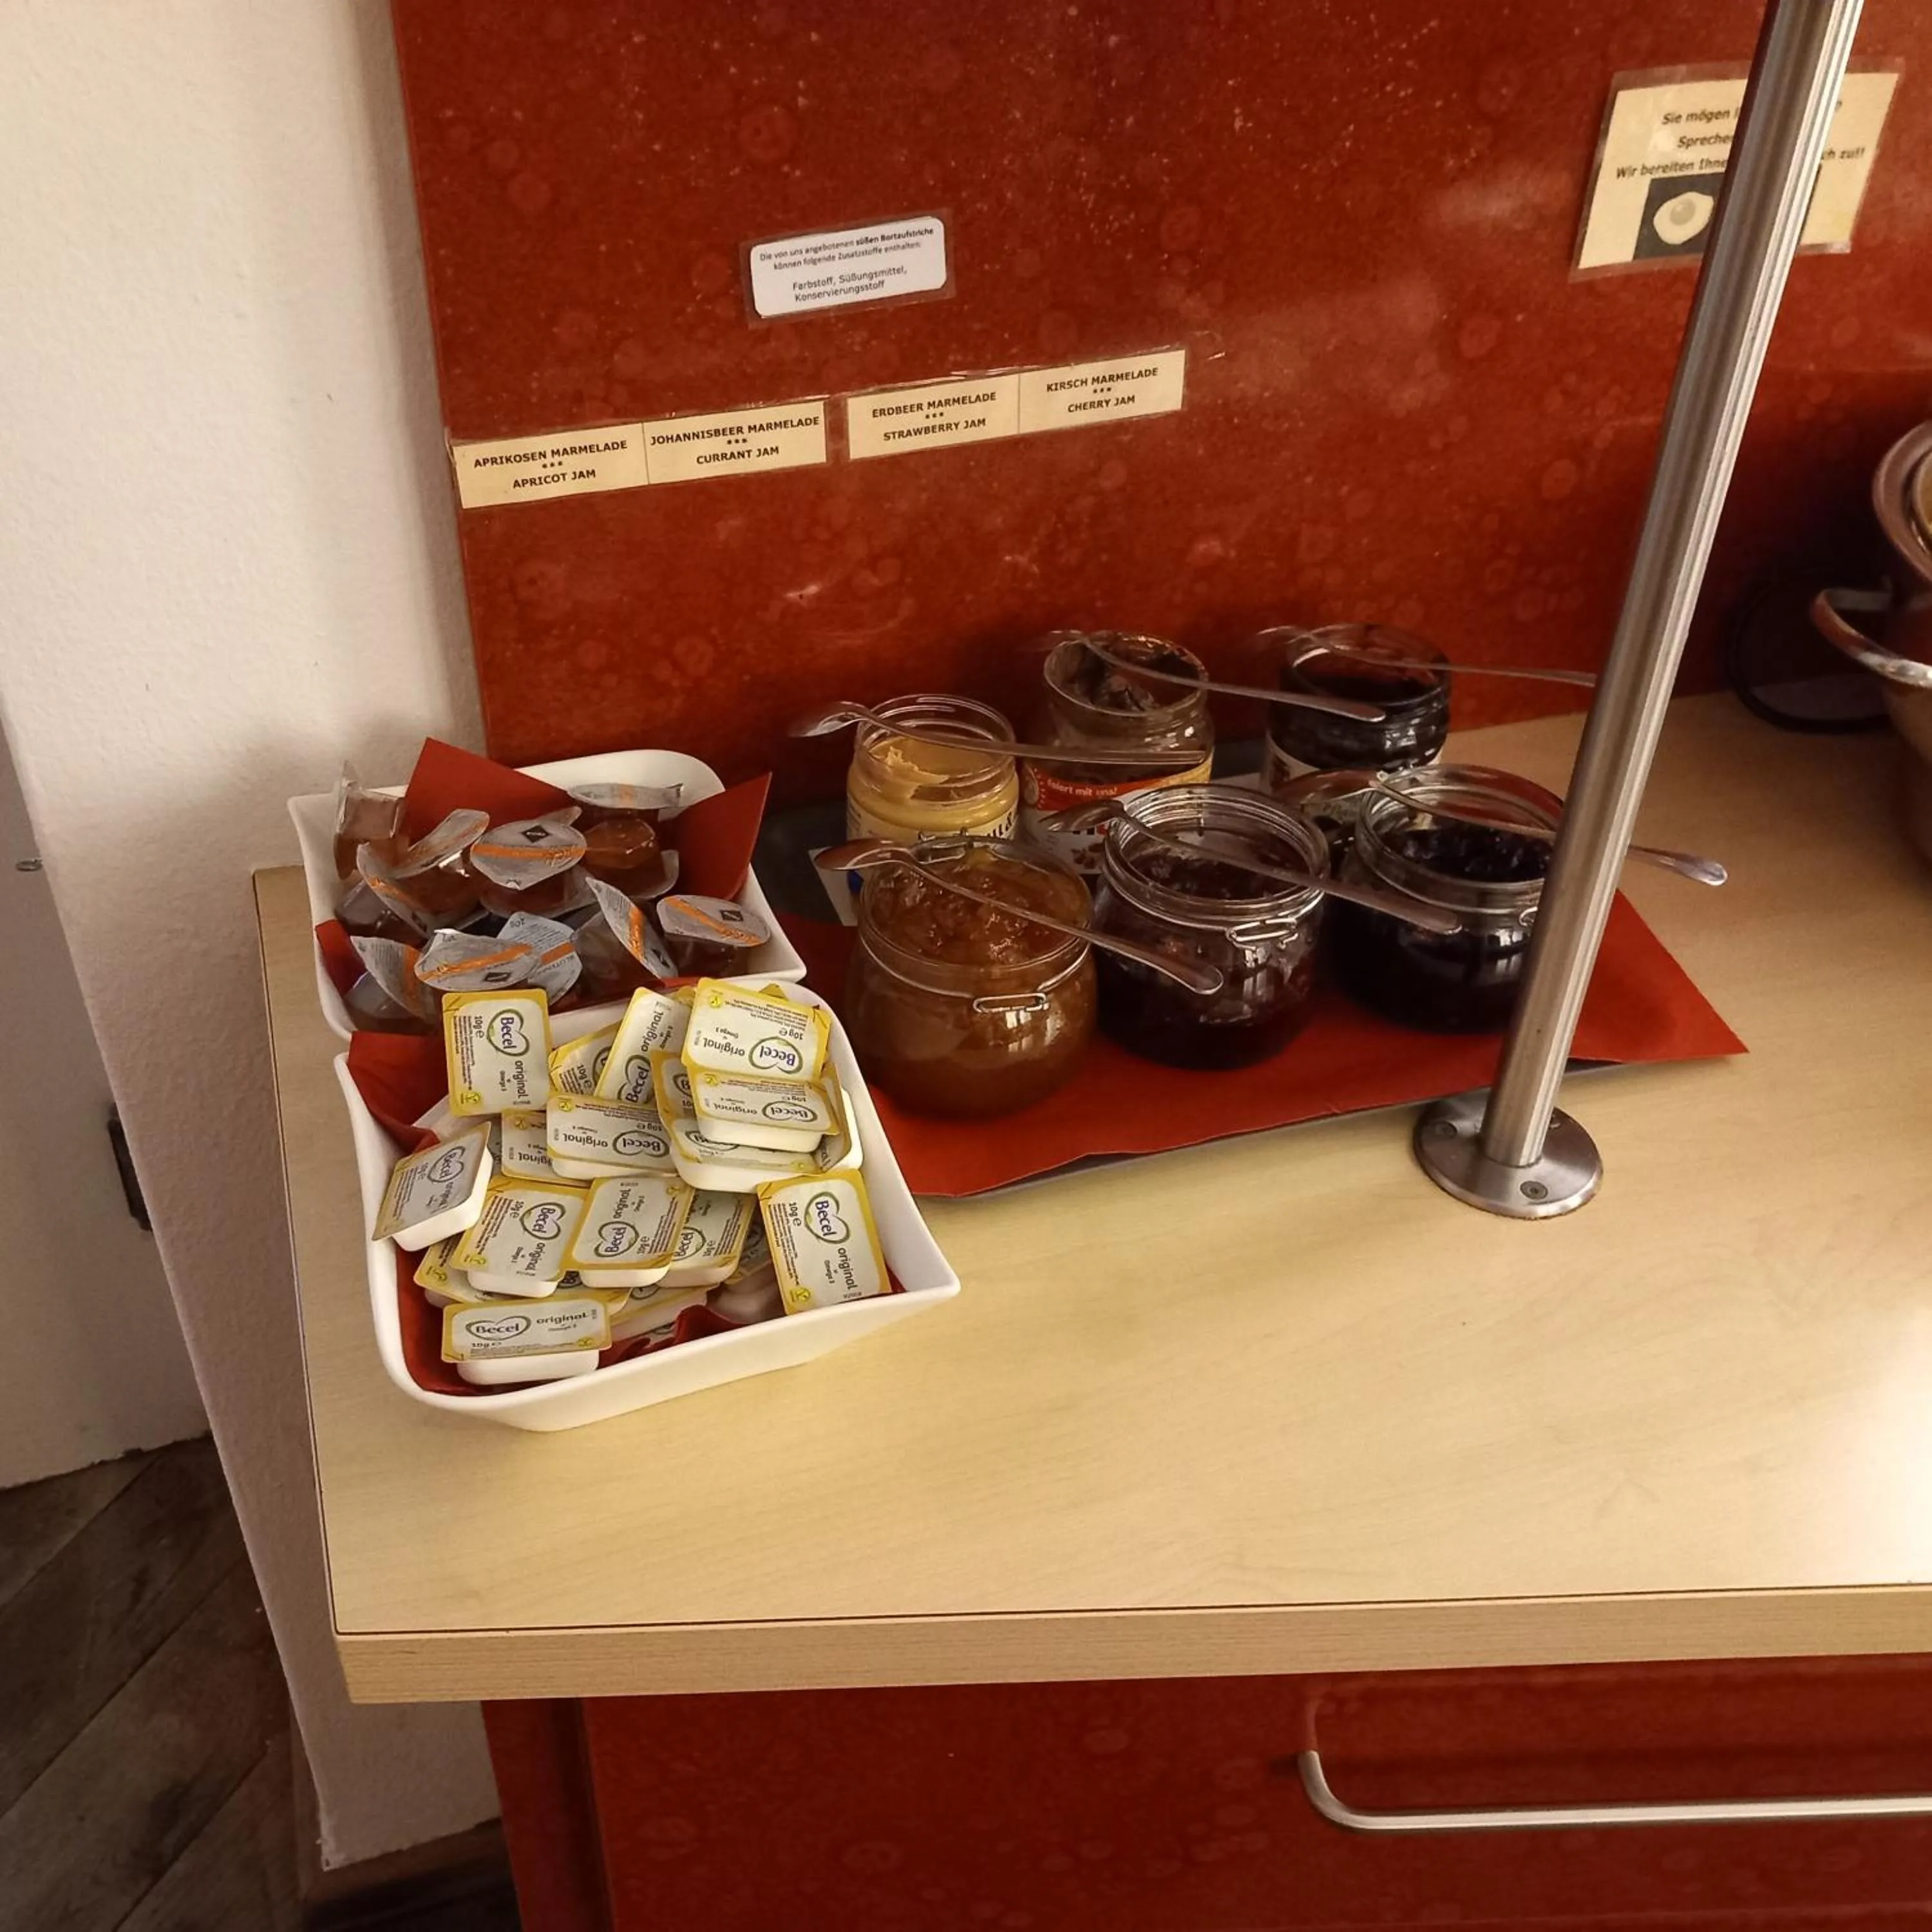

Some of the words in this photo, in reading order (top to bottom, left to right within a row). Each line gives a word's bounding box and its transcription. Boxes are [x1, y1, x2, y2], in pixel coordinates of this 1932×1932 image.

[1661, 111, 1682, 125] Sie
[1685, 109, 1730, 123] mögen
[1677, 131, 1733, 149] Spreche
[1616, 166, 1637, 179] Wir
[1640, 160, 1694, 176] bereiten
[1698, 158, 1728, 171] Ihne
[760, 252, 772, 261] Die
[774, 251, 788, 259] von
[790, 249, 803, 257] uns
[774, 261, 802, 270] können
[803, 254, 836, 266] folgende
[838, 246, 882, 260] Zusatzstoffe
[793, 276, 836, 290] Farbstoff,
[838, 265, 907, 284] Süßungsmittel,
[795, 279, 886, 302] Konservierungsstoff
[1046, 378, 1088, 393] KIRSCH
[1091, 368, 1158, 386] MARMELADE
[872, 402, 924, 418] ERDBEER
[927, 392, 997, 411] MARMELADE
[1067, 398, 1112, 413] CHERRY
[1114, 395, 1136, 407] JAM
[650, 426, 744, 446] JOHANNISBEER
[748, 416, 820, 435] MARMELADE
[883, 422, 960, 442] STRAWBERRY
[963, 418, 987, 431] JAM
[474, 450, 547, 469] APRIKOSEN
[551, 440, 628, 459] MARMELADE
[696, 449, 754, 465] CURRANT
[756, 446, 780, 459] JAM
[513, 472, 567, 489] APRICOT
[571, 469, 596, 482] JAM
[1075, 788, 1093, 796] mit
[473, 1016, 483, 1030] 10g
[500, 1017, 517, 1050] Becel
[640, 1011, 665, 1053] original
[789, 1028, 804, 1040] 10g
[703, 1037, 746, 1057] original
[759, 1045, 796, 1067] Becel
[513, 1060, 529, 1099] original
[625, 1065, 650, 1103] Becel
[562, 1133, 609, 1148] original
[622, 1137, 661, 1153] Becel
[612, 1188, 632, 1220] original
[788, 1202, 799, 1218] 10g
[531, 1207, 556, 1234] Becel
[815, 1200, 837, 1236] Becel
[605, 1226, 627, 1253] Becel
[524, 1242, 545, 1271] original
[837, 1247, 858, 1291] original
[475, 1322, 520, 1334] Becel
[536, 1311, 588, 1325] original
